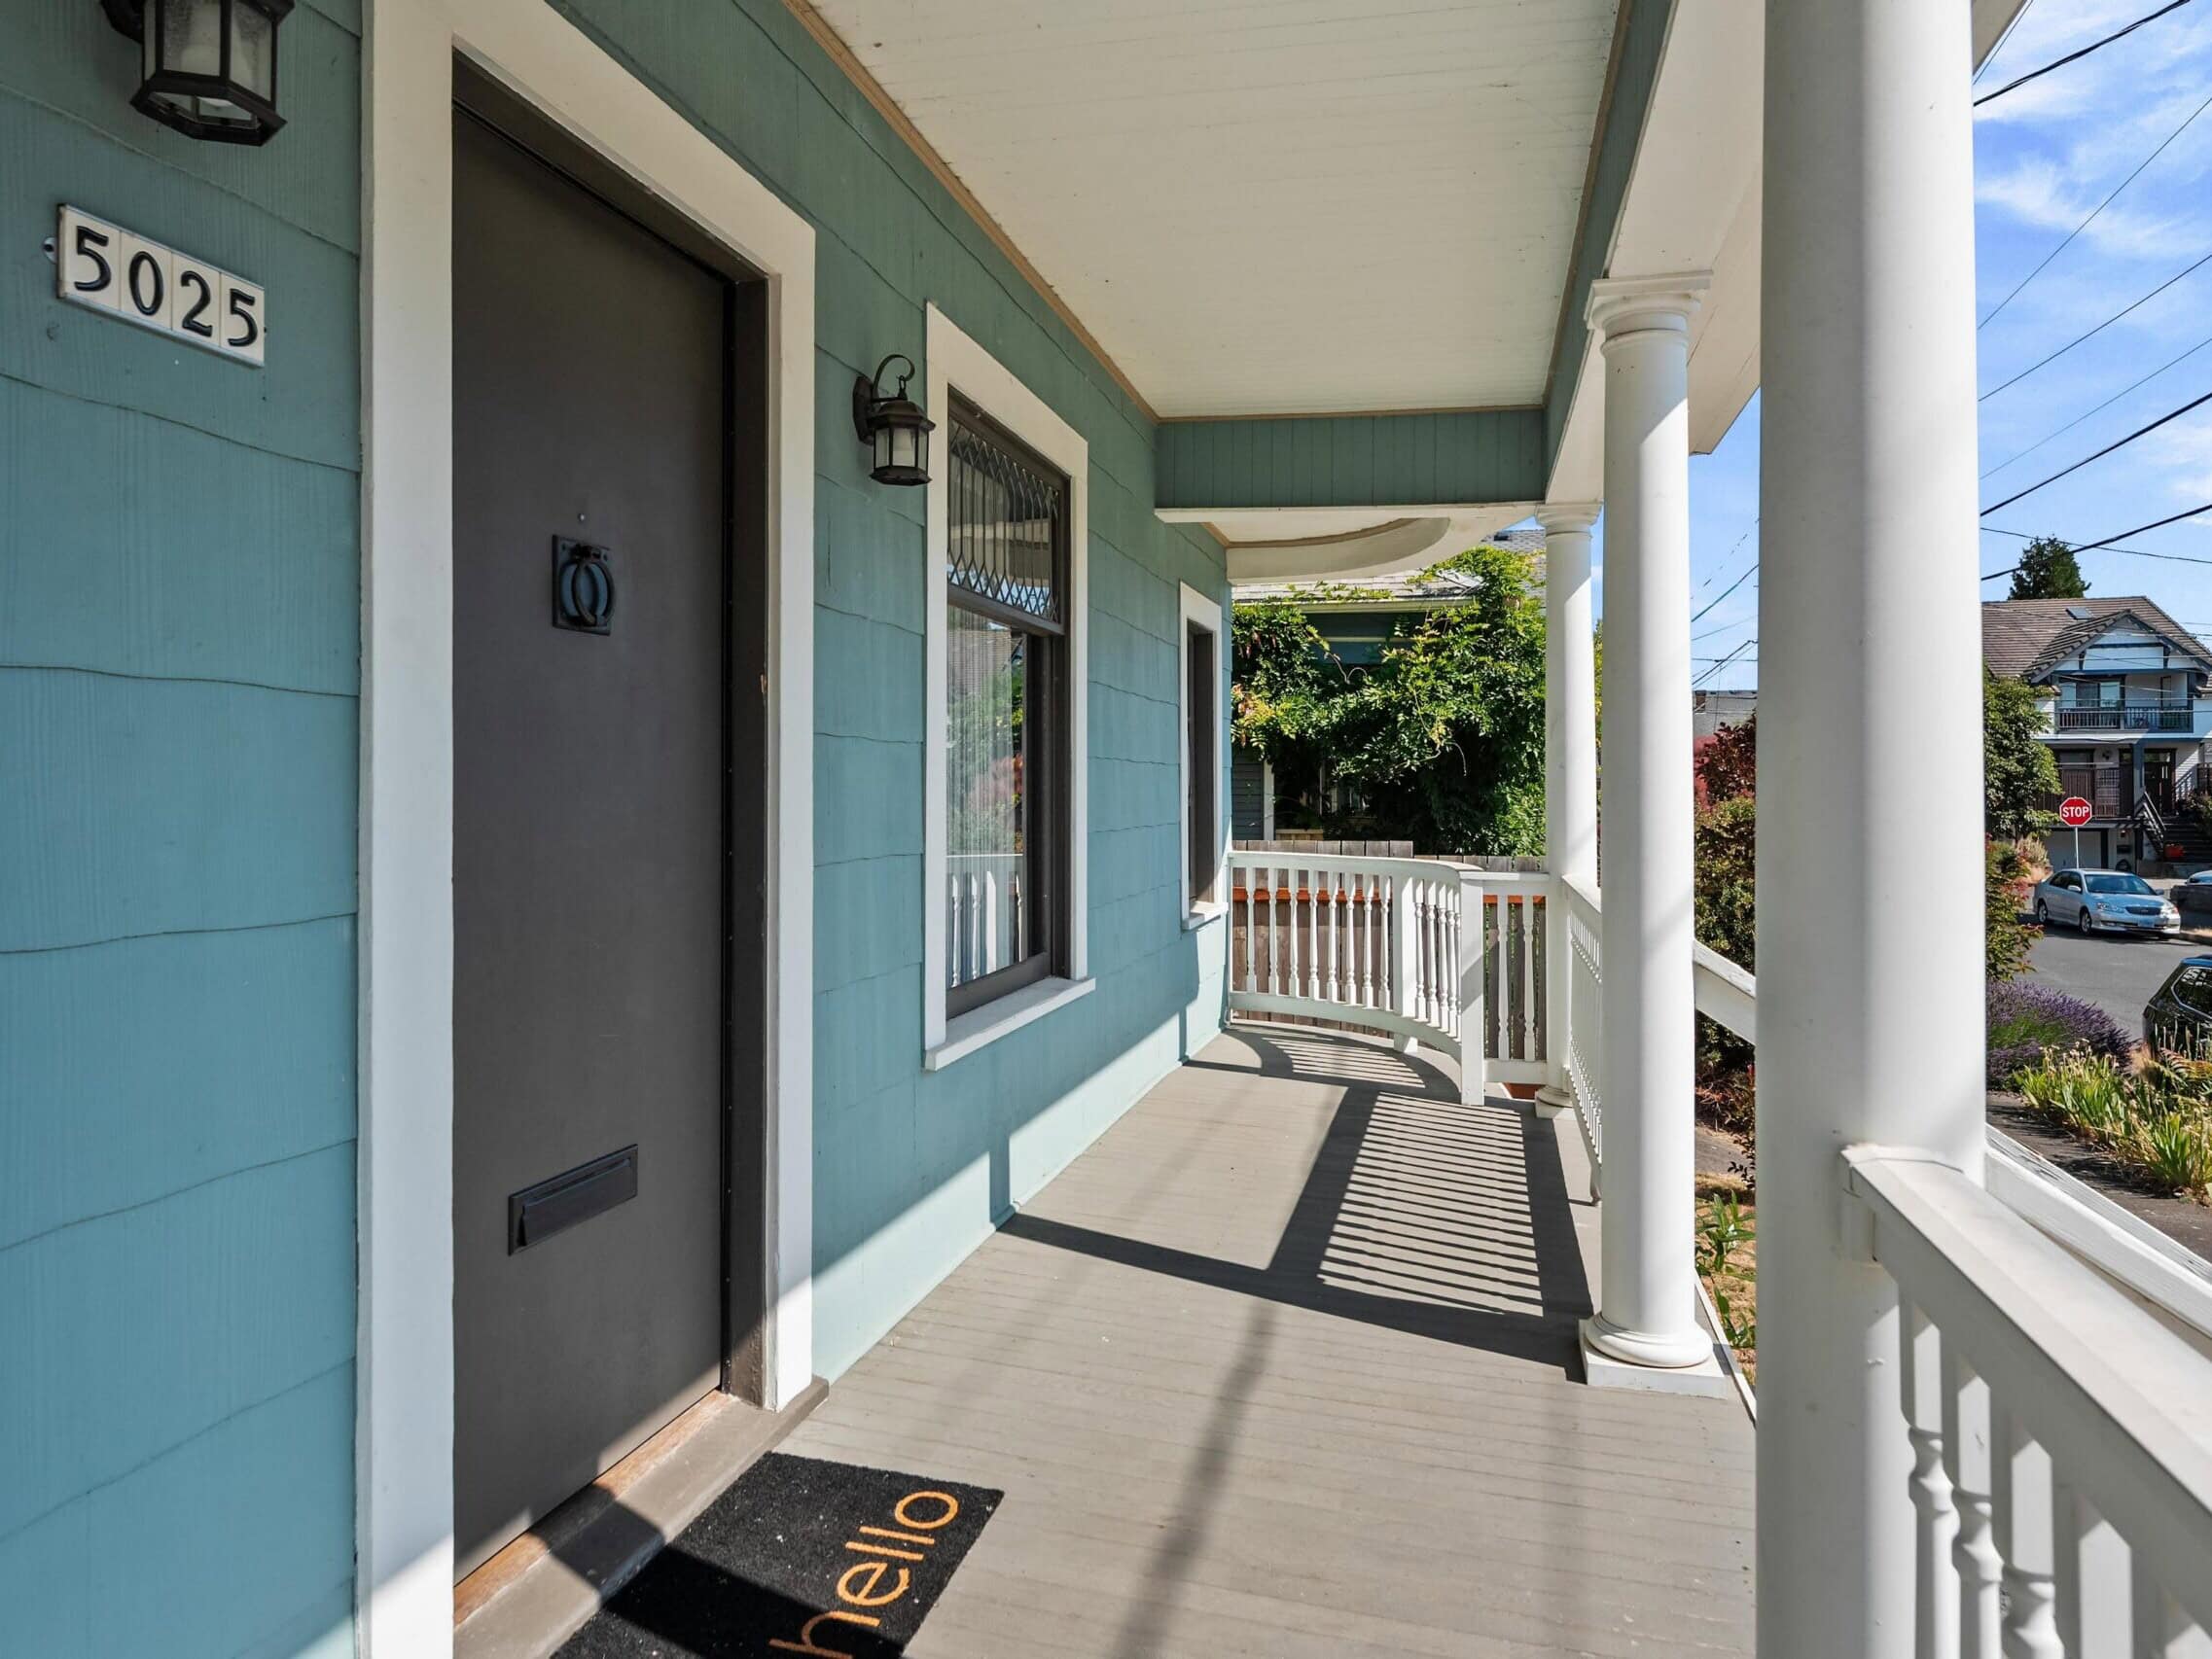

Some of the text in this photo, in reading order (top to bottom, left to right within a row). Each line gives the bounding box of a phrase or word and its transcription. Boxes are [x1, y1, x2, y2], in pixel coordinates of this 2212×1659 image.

[74, 225, 258, 347] 5025
[2062, 806, 2089, 818] STOP
[768, 1490, 959, 1659] hello
